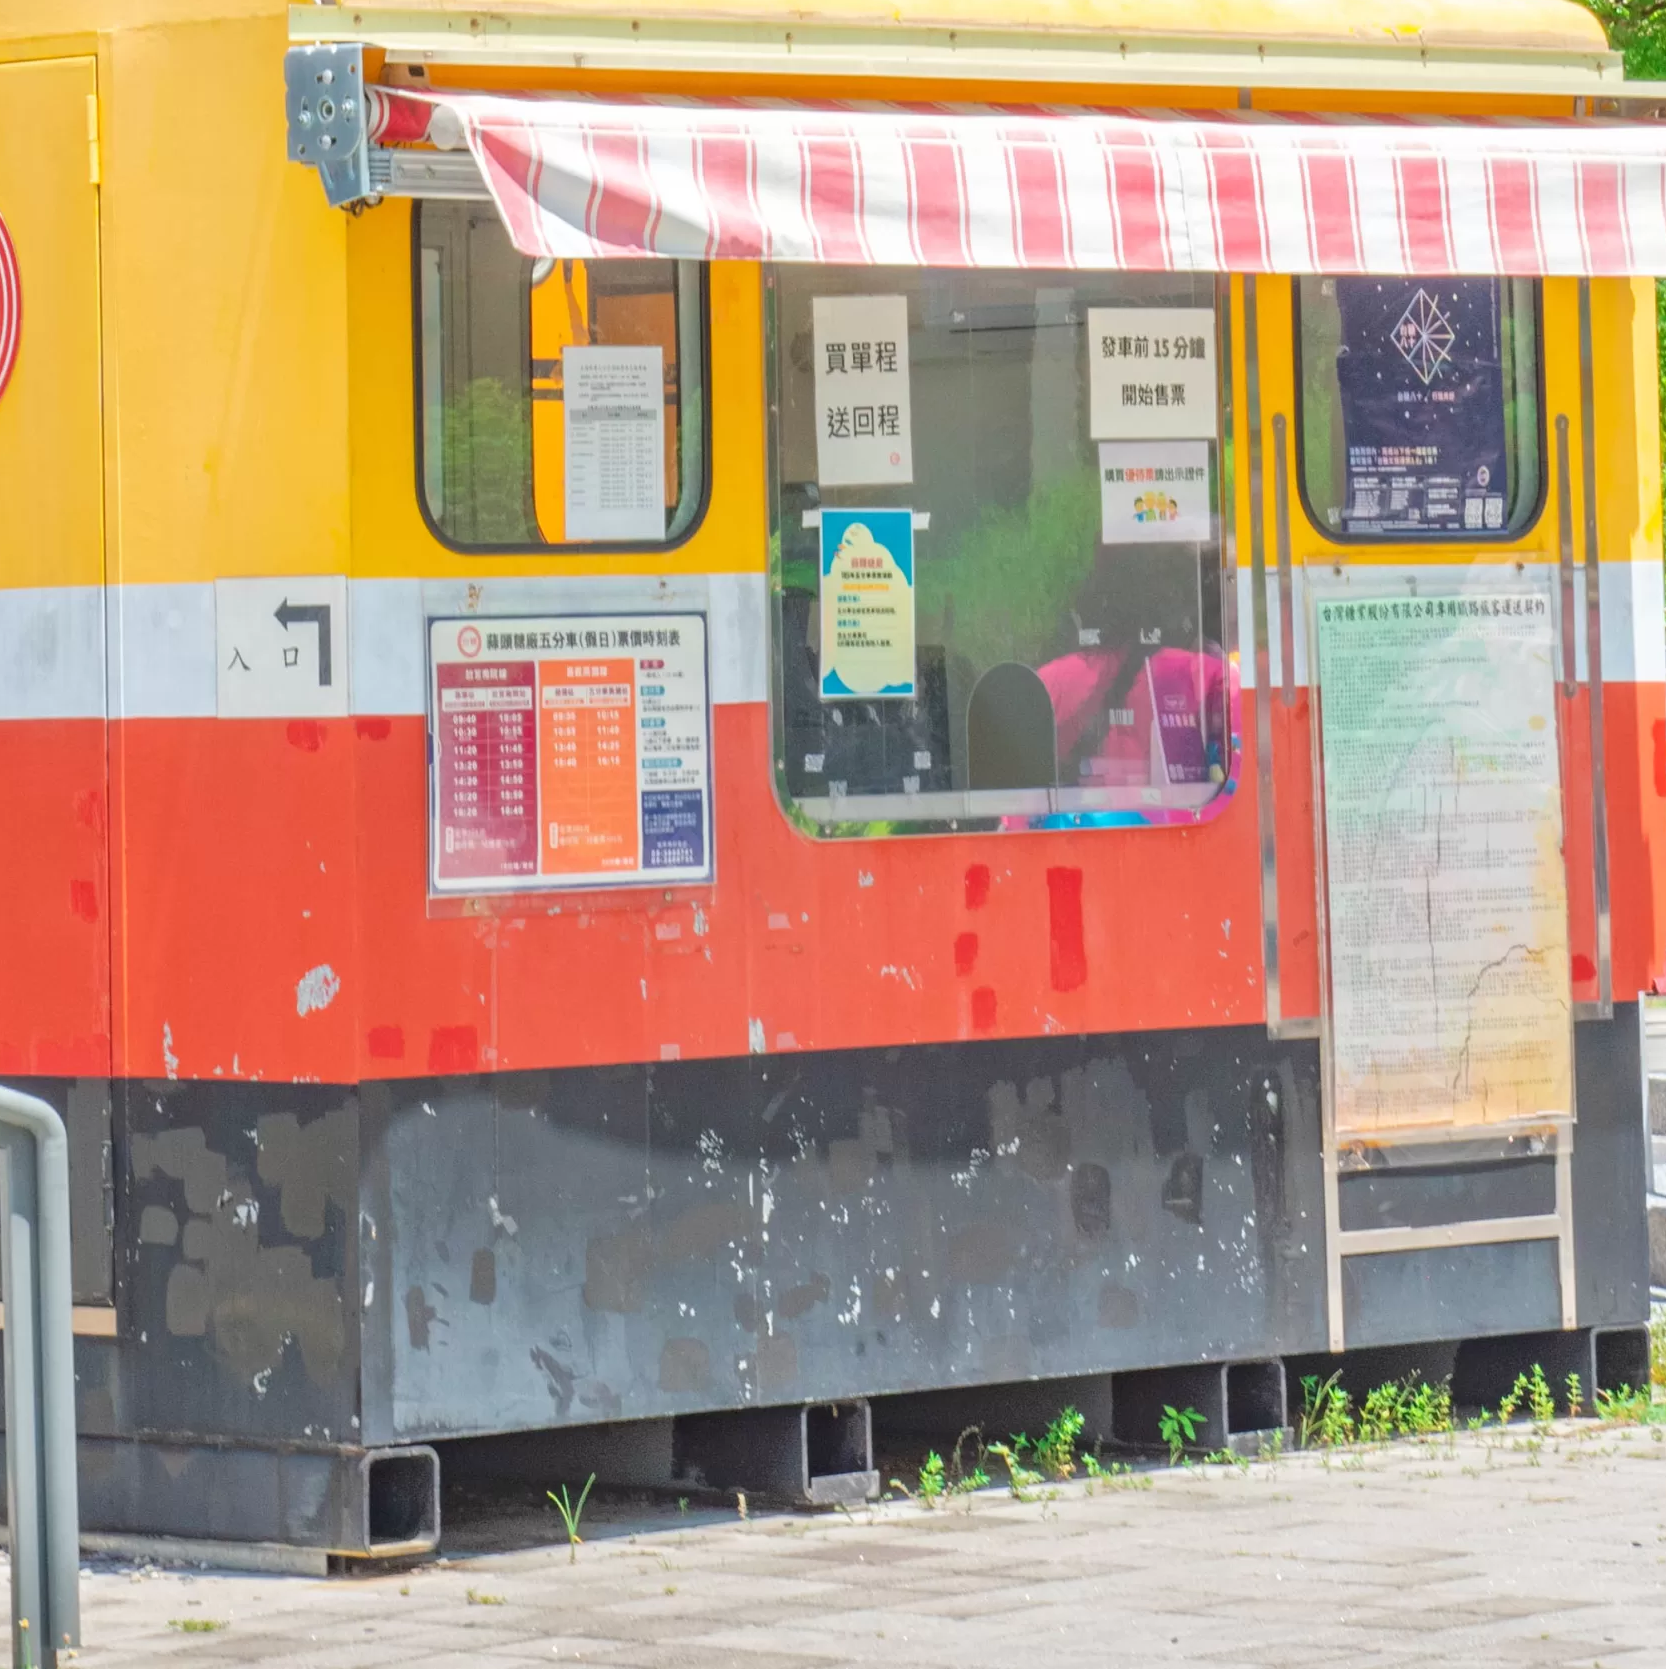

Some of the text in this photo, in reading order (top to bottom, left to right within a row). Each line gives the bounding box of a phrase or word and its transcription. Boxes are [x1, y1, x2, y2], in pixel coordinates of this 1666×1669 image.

[825, 341, 898, 375] 買單程
[1101, 335, 1206, 360] 發車前 15 分鐘
[1121, 383, 1186, 407] 開始售票
[827, 404, 900, 438] 送回程
[227, 646, 299, 671] 入口
[454, 745, 477, 755] 11:20
